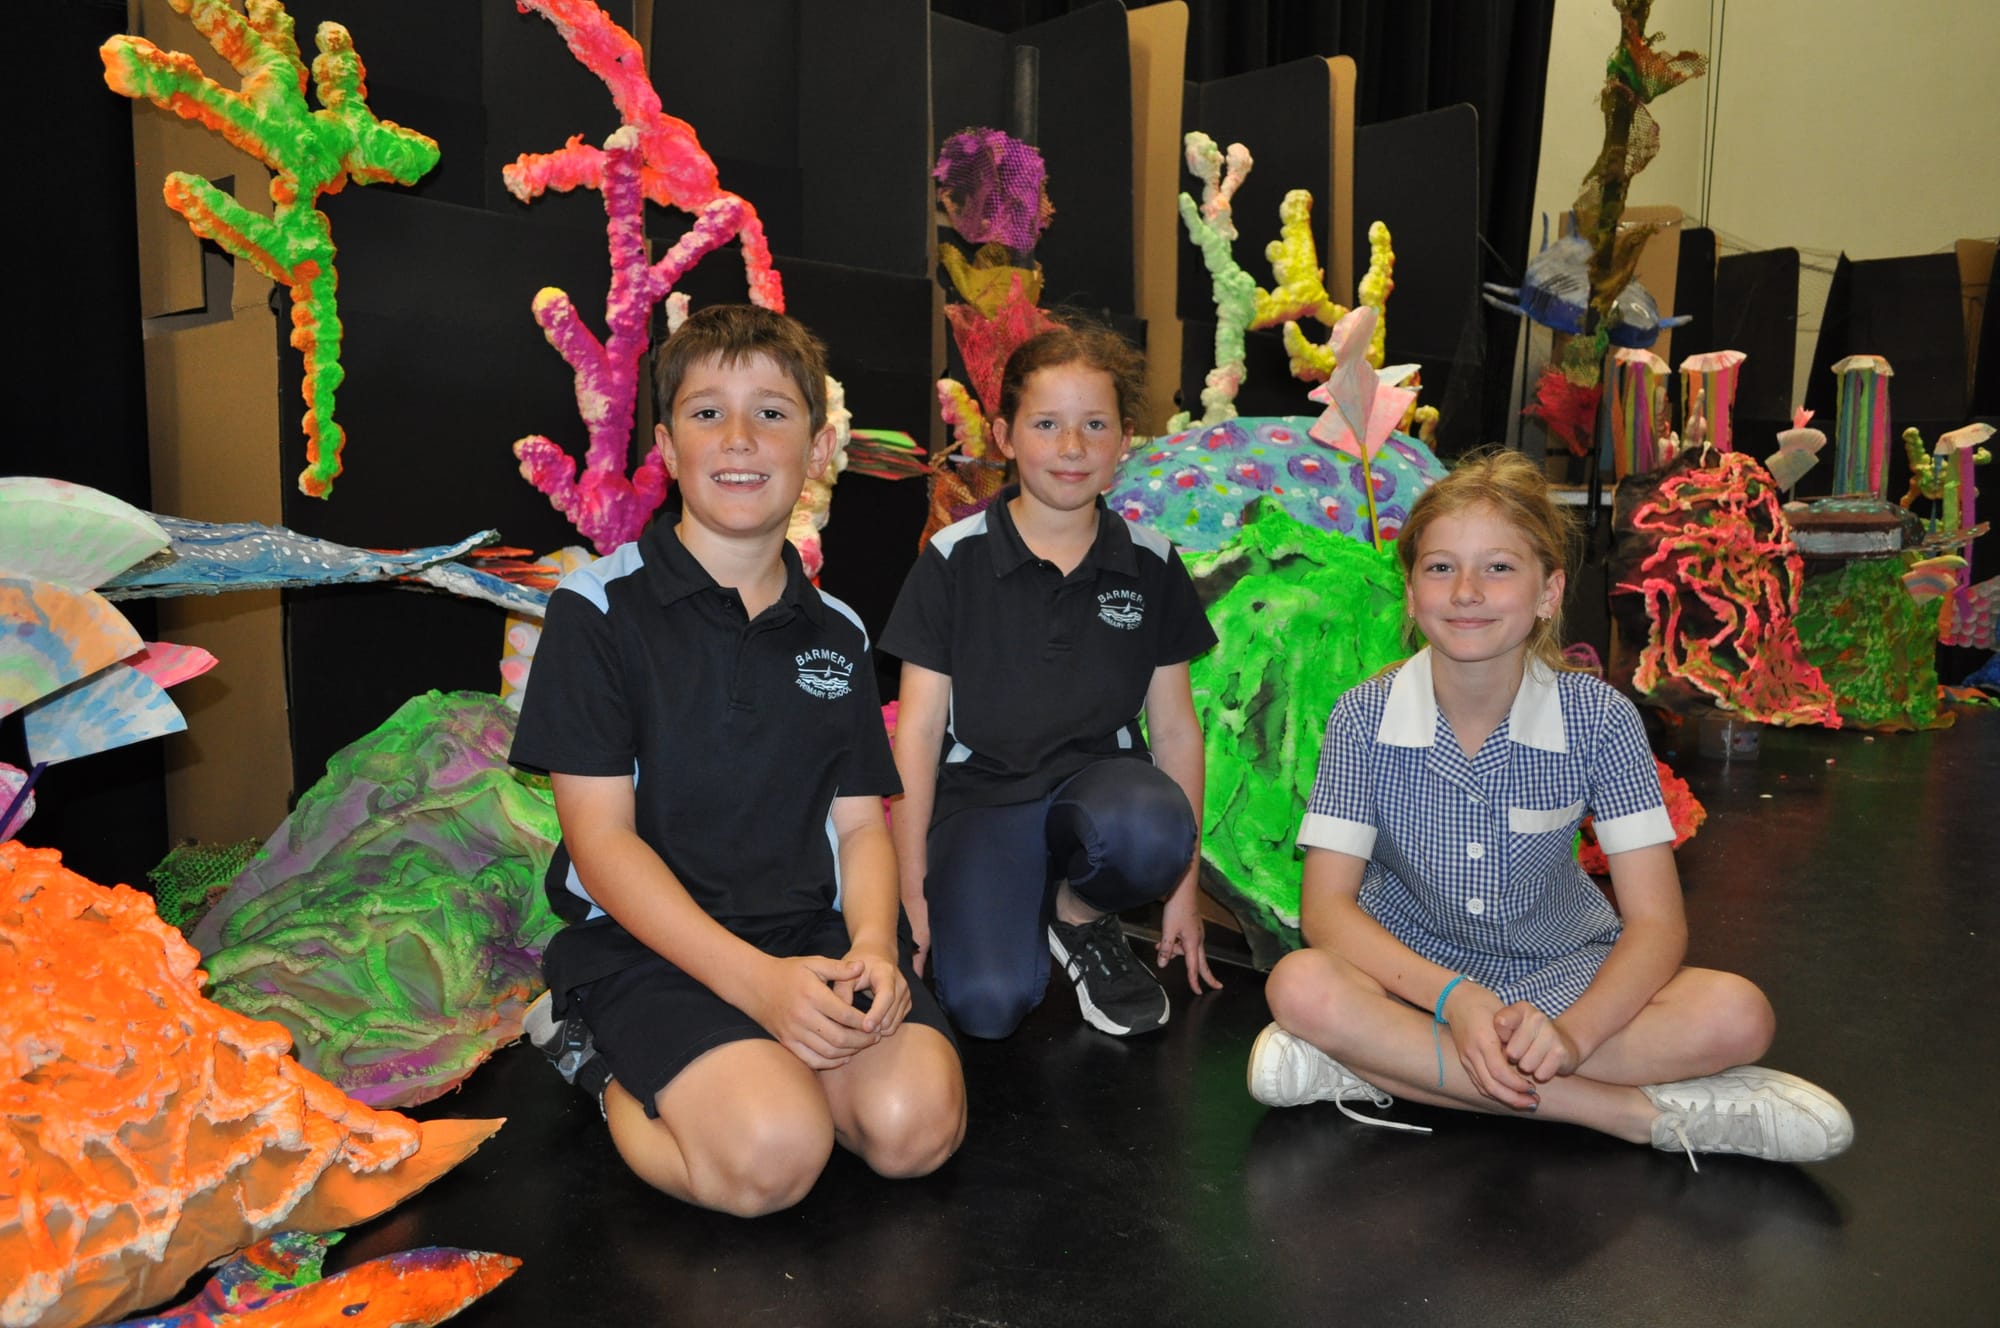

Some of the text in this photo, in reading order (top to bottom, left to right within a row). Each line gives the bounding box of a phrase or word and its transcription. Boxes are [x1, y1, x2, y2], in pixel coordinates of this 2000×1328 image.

[795, 648, 853, 673] BARMERA
[795, 678, 852, 700] PRIMARY SCHOOL
